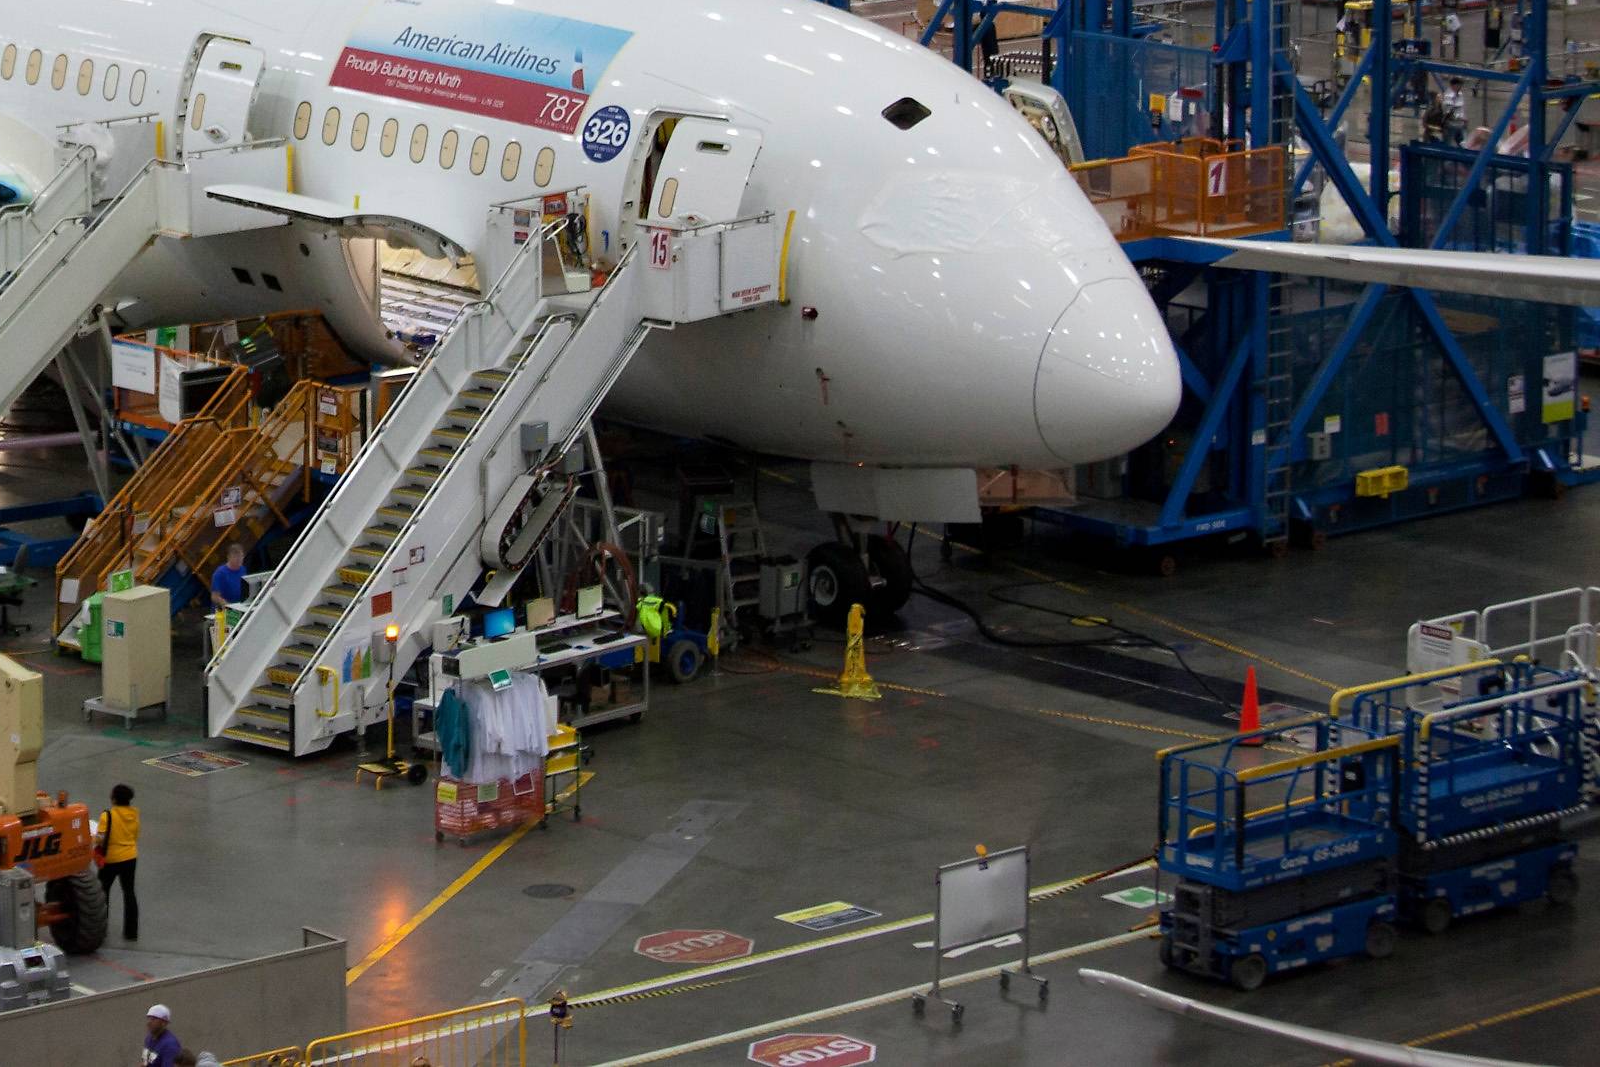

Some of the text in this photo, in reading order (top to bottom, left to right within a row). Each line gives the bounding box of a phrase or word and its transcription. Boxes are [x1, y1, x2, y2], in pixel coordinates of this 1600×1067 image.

[393, 26, 561, 75] American Airlines
[345, 54, 462, 88] Proudly Building the Ninth
[539, 92, 585, 124] 787
[584, 117, 629, 147] 326
[652, 232, 668, 266] 15
[14, 832, 62, 863] JLG
[1280, 855, 1309, 871] Genie
[645, 933, 726, 958] STOP
[777, 1039, 865, 1067] STOP
